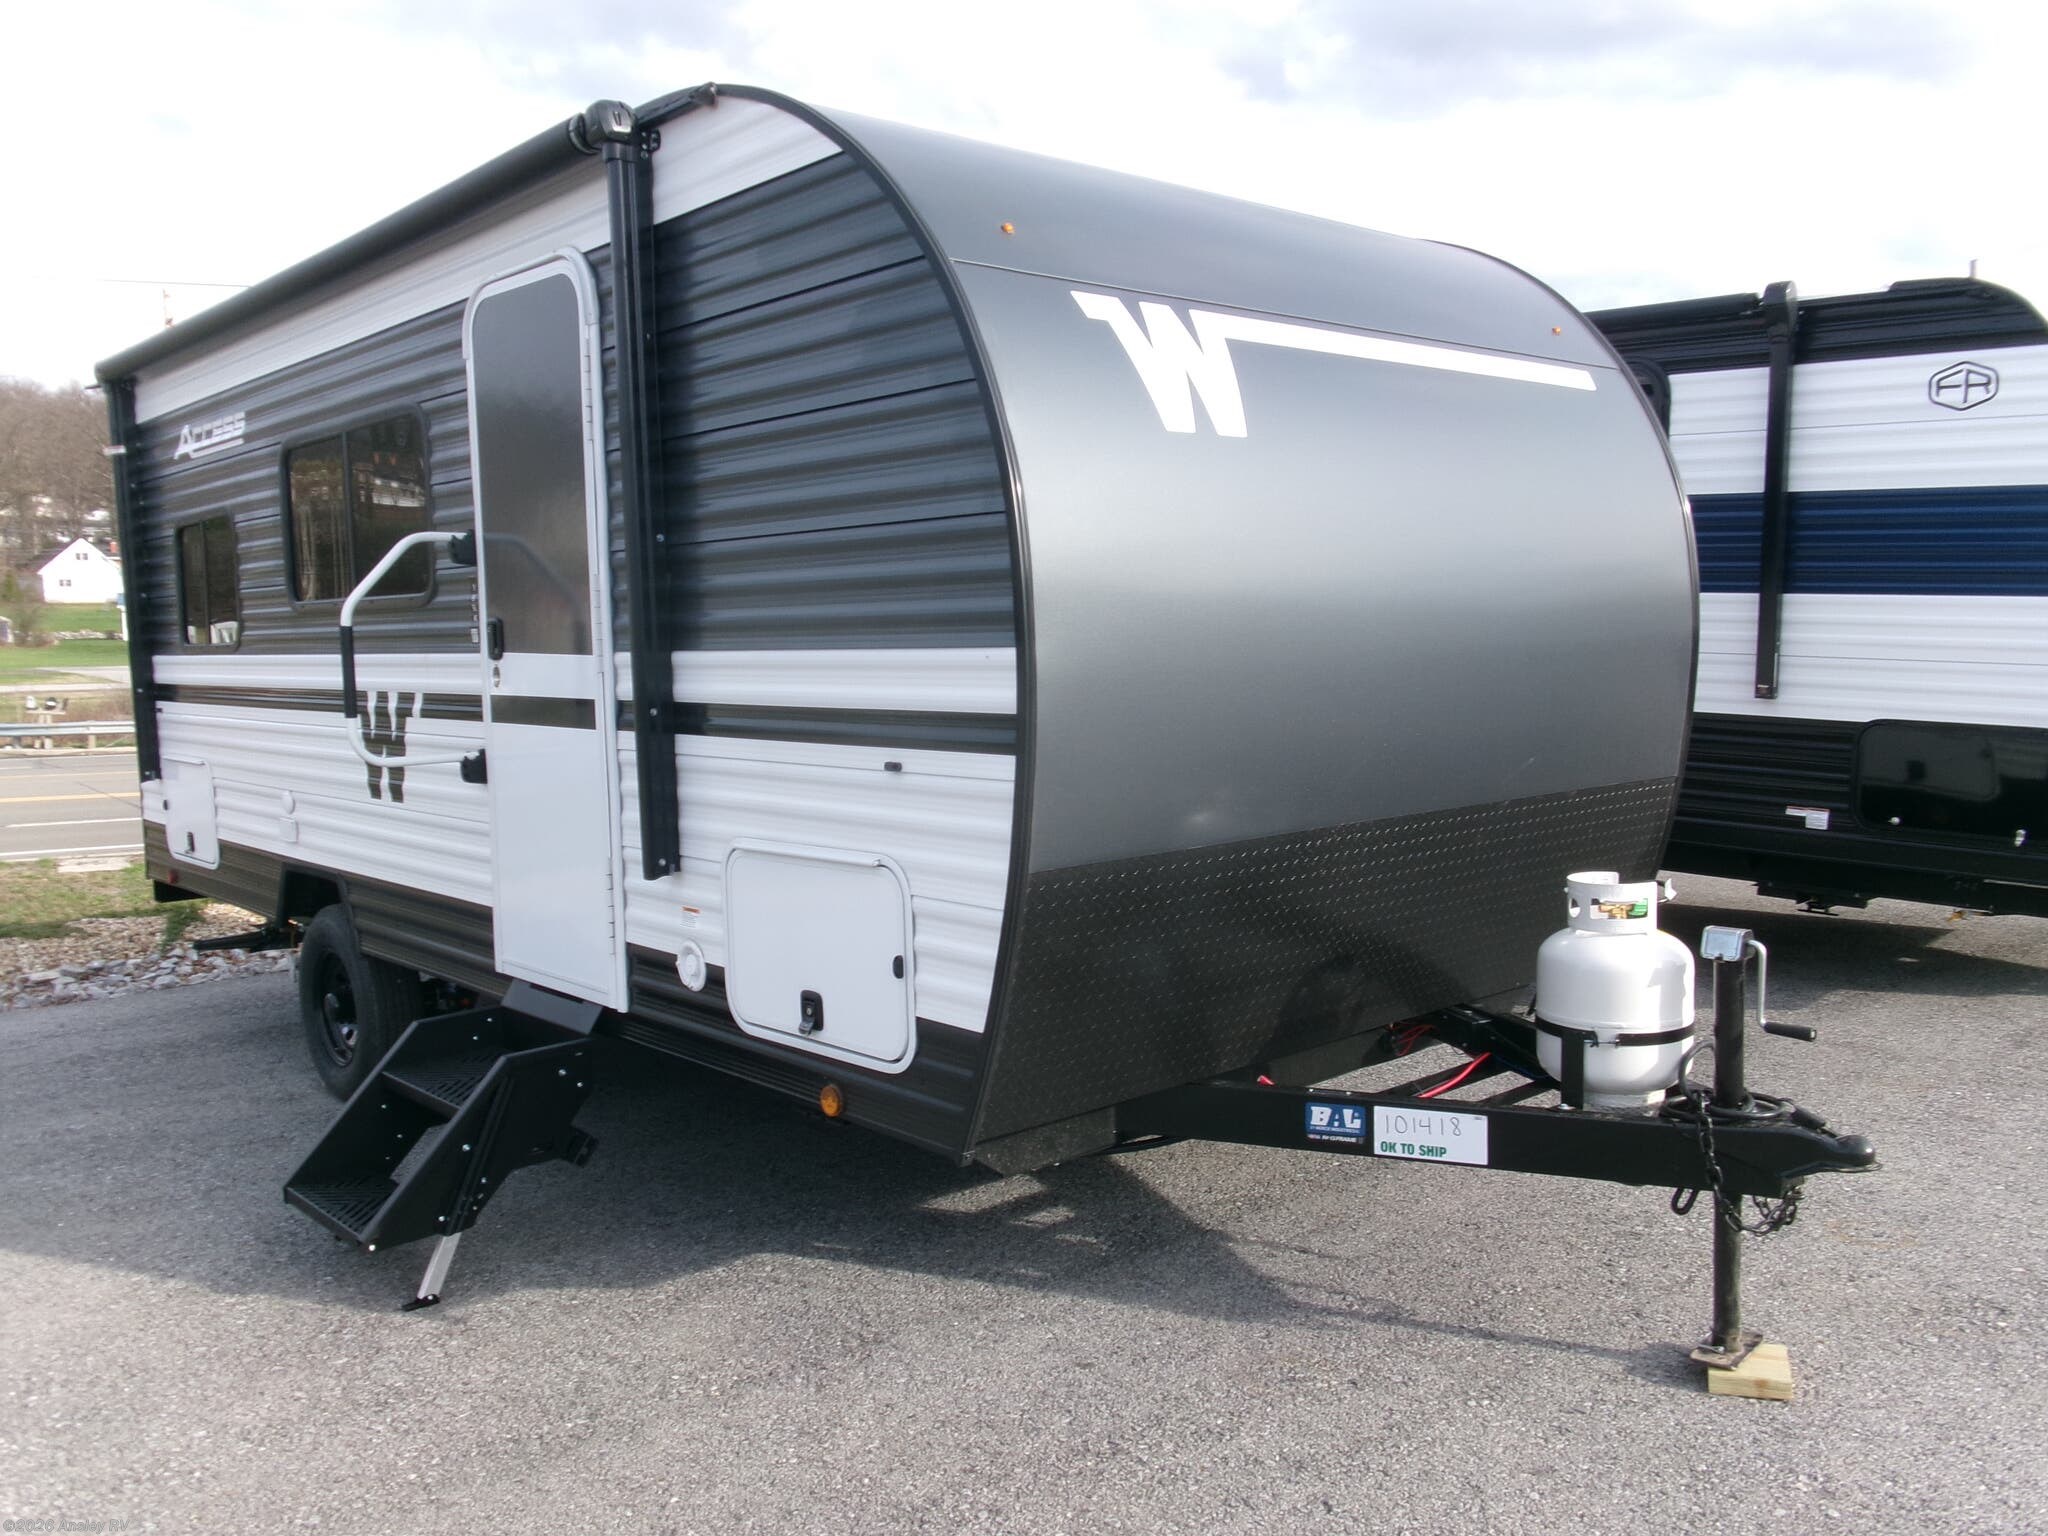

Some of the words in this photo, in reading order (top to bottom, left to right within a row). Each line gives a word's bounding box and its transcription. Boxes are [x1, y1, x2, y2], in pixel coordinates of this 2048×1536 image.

[1070, 290, 1248, 438] W
[1935, 368, 1992, 404] FR
[1310, 1106, 1362, 1129] BAL
[1384, 1114, 1463, 1137] 101418
[1380, 1140, 1398, 1154] OK
[1401, 1142, 1415, 1155] TO
[1418, 1144, 1448, 1158] SHIP
